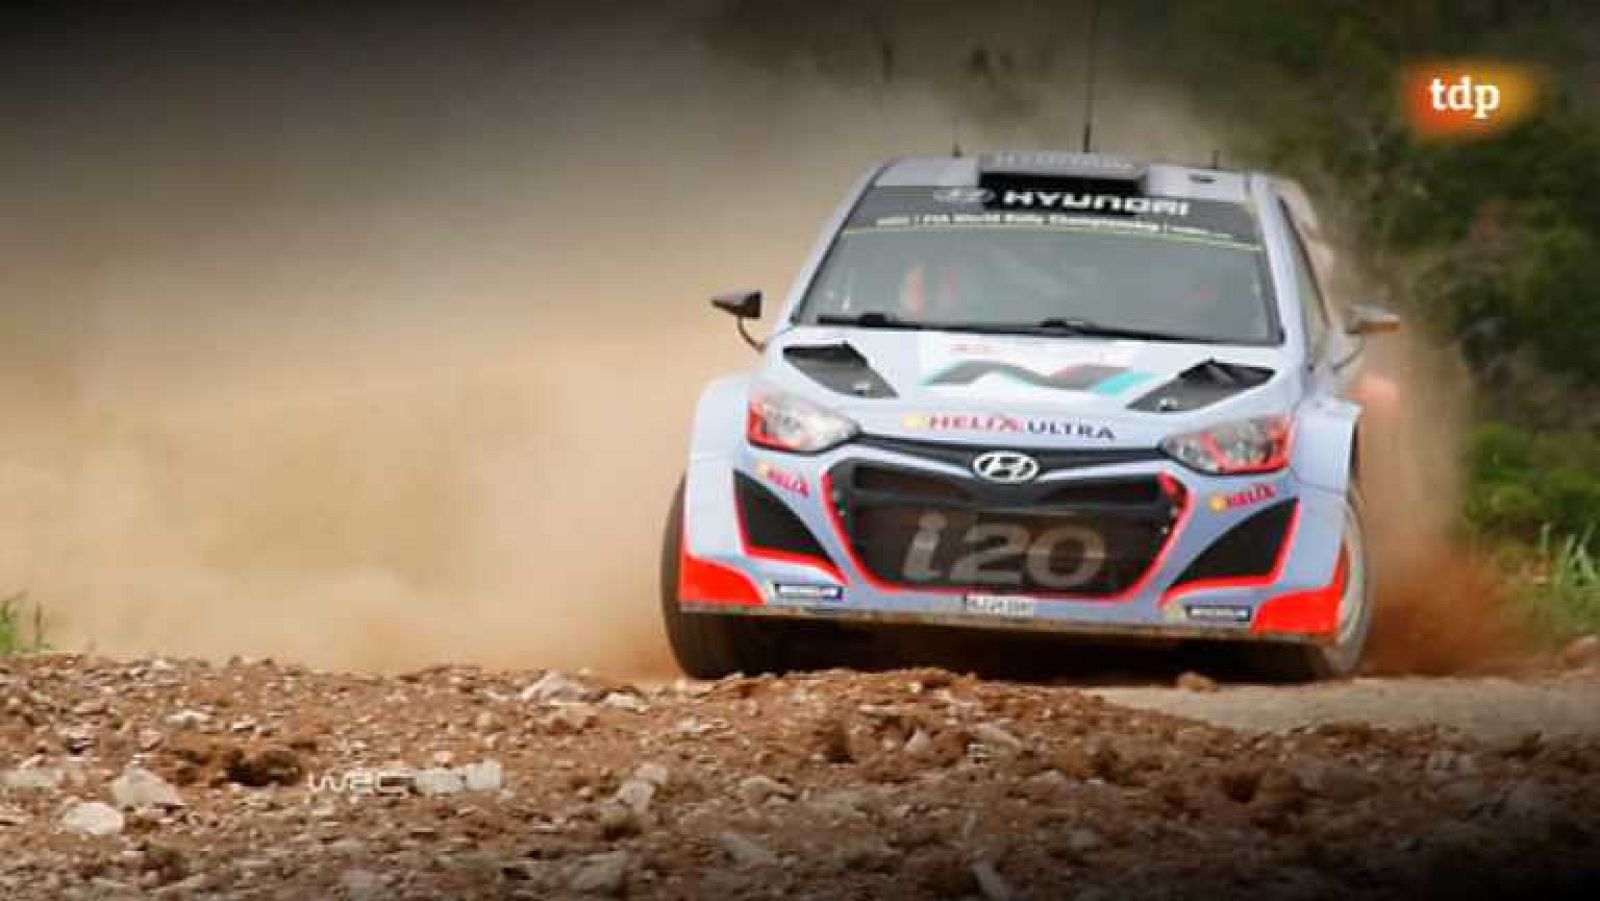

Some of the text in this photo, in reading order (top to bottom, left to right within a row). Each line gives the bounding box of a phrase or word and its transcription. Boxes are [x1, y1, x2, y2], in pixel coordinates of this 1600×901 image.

[1004, 189, 1190, 217] HYUNDAI
[929, 413, 1117, 441] HELIX ULTRA
[903, 511, 1106, 587] i20
